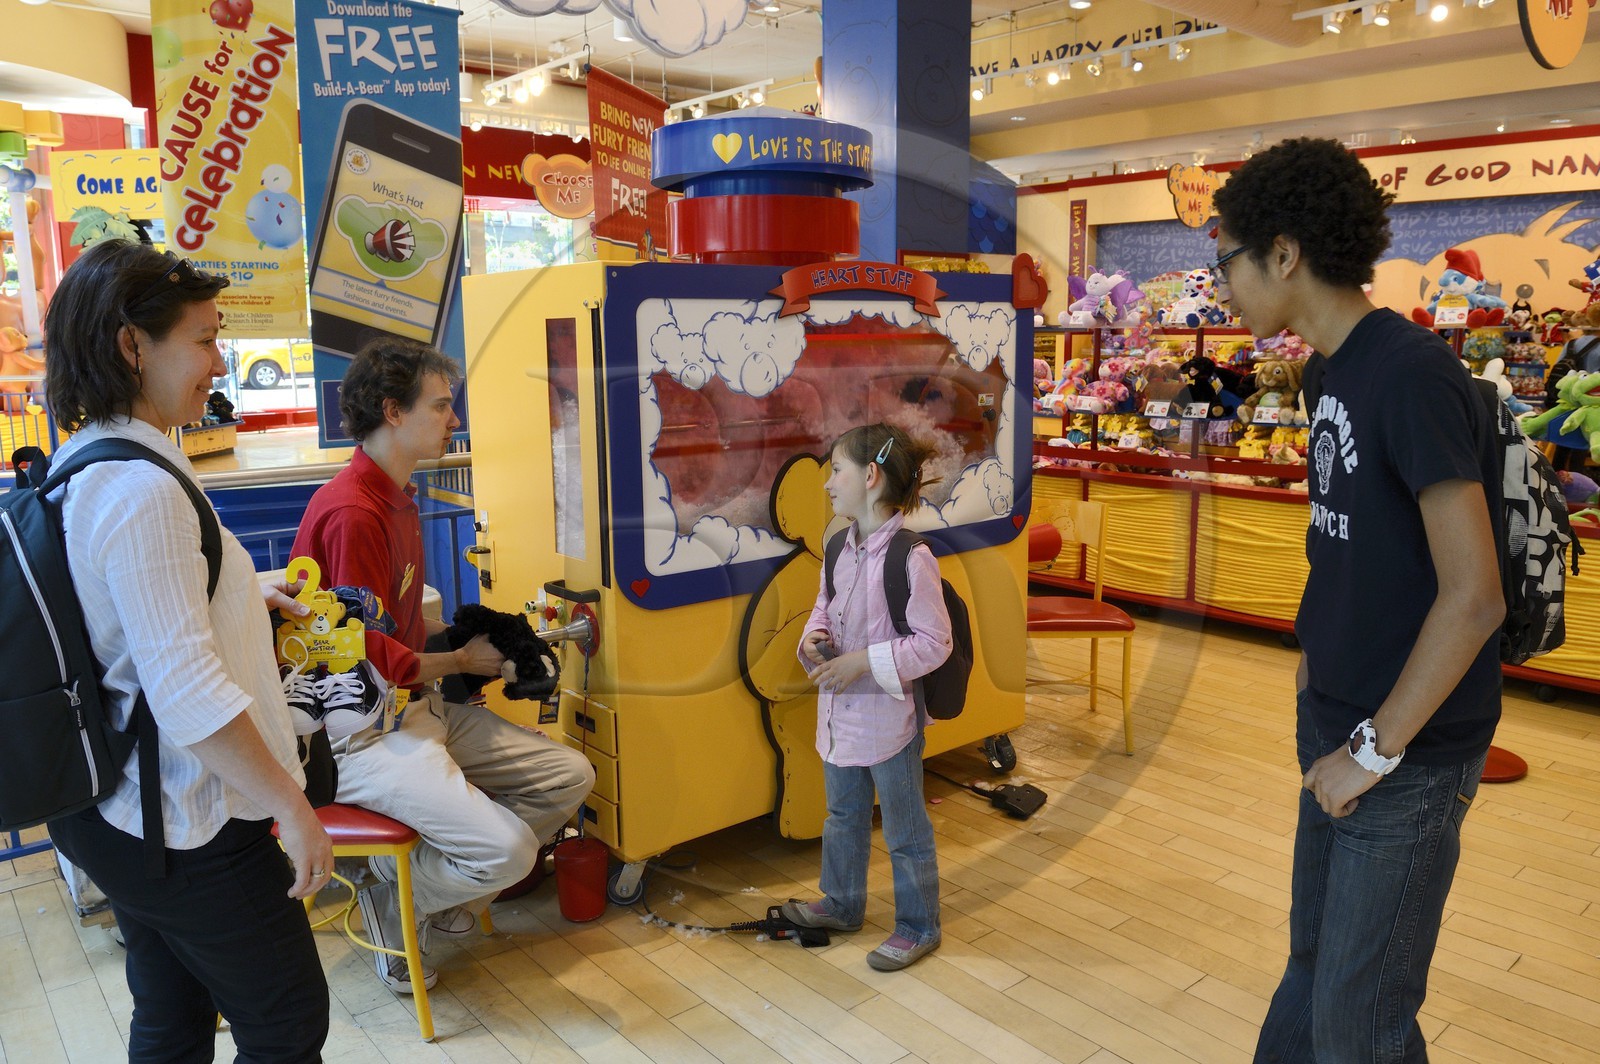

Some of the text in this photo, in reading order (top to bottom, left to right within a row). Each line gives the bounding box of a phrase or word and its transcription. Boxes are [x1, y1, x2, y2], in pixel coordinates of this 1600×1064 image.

[327, 0, 413, 17] Download the
[313, 18, 438, 81] FREE
[970, 61, 999, 77] AVE
[395, 79, 415, 96] App
[418, 78, 451, 95] today!
[159, 40, 234, 183] CAUSE for
[600, 101, 655, 140] BRING NEW
[593, 123, 652, 161] FURRY FRIEN
[748, 133, 789, 161] LOVE
[820, 138, 844, 164] THE
[597, 150, 608, 167] TO
[622, 159, 646, 179] ONLINE
[1380, 153, 1600, 190] OF GOOD NAM
[76, 173, 124, 195] COME
[541, 171, 593, 188] CHOOSE
[1182, 180, 1210, 196] NAME
[372, 181, 425, 210] What's Hot
[556, 186, 581, 206] ME
[611, 176, 647, 220] FREE!
[1187, 199, 1202, 213] ME
[1073, 205, 1084, 237] LOVE!
[230, 261, 280, 270] STARTING
[230, 271, 254, 281] $10
[811, 265, 914, 291] HEART STUFF
[342, 279, 355, 289] The
[355, 284, 373, 296] latest
[374, 289, 390, 302] furry
[343, 290, 370, 304] fashions
[371, 300, 385, 309] and
